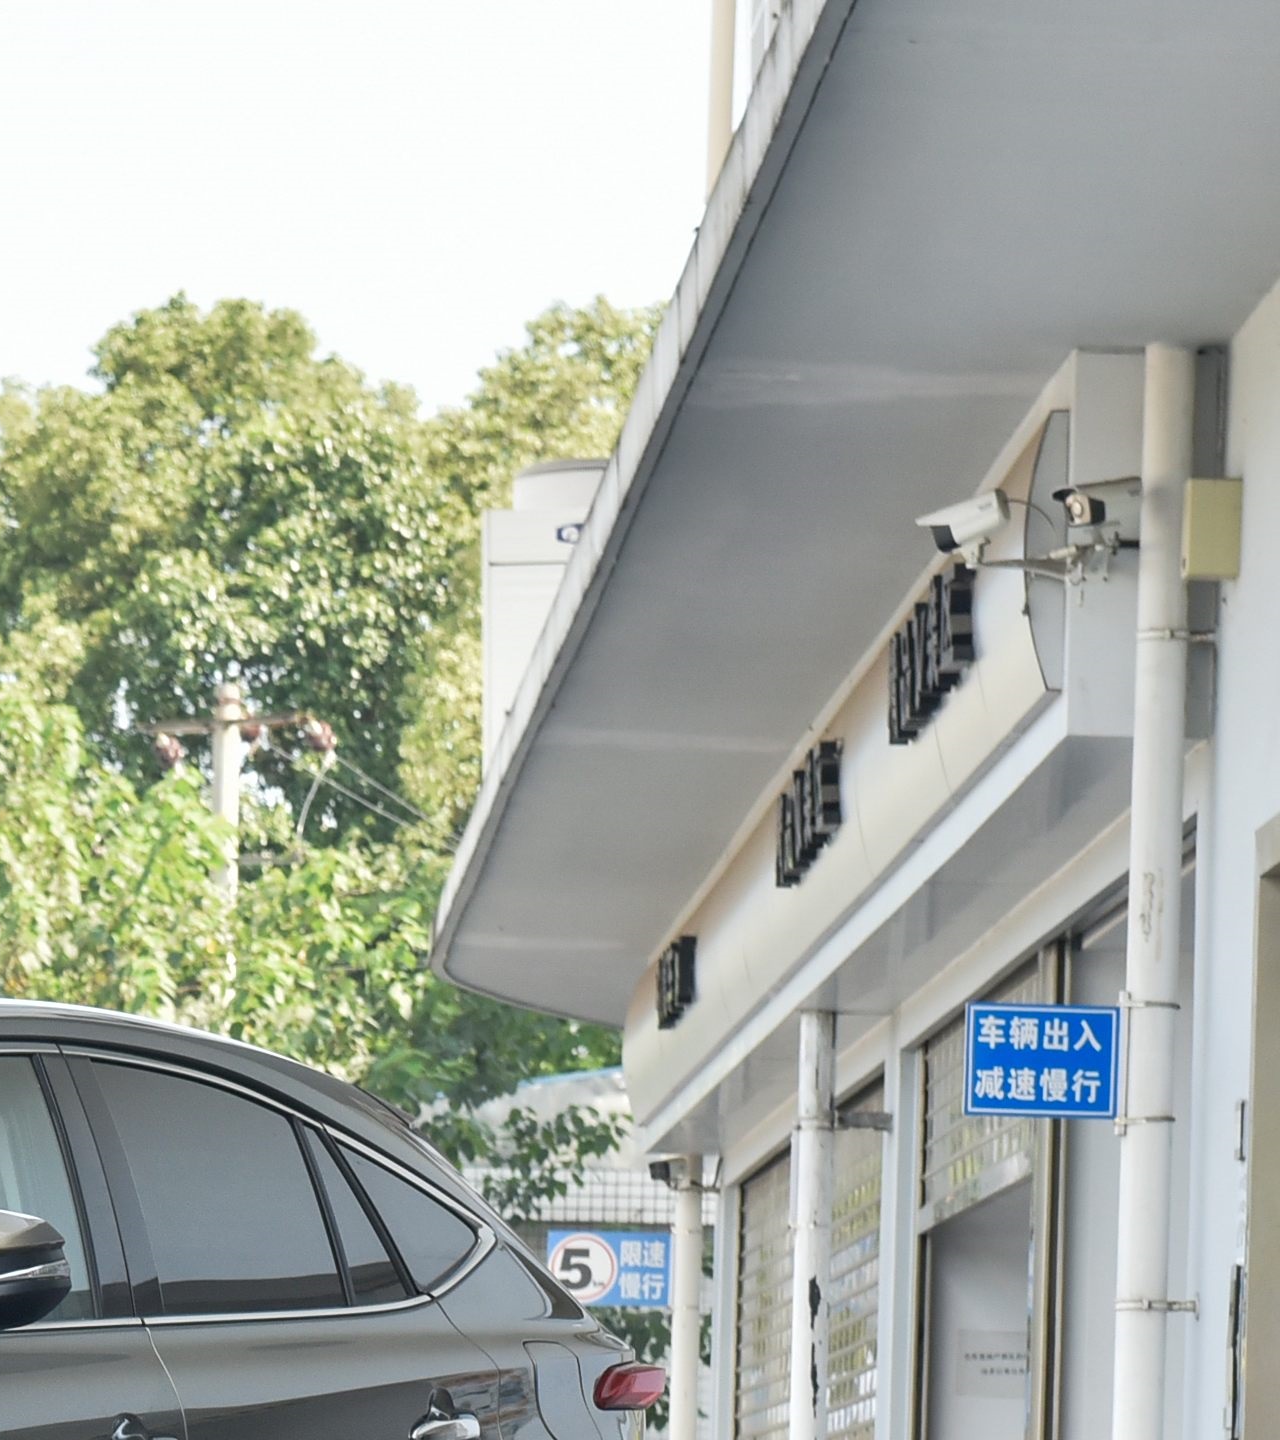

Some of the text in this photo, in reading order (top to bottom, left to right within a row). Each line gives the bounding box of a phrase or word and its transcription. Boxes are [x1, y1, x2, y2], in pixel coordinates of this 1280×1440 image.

[977, 1015, 1102, 1052] 车辆出入
[974, 1066, 1101, 1103] 减速慢行
[560, 1248, 592, 1289] 5
[620, 1240, 665, 1268] 限速
